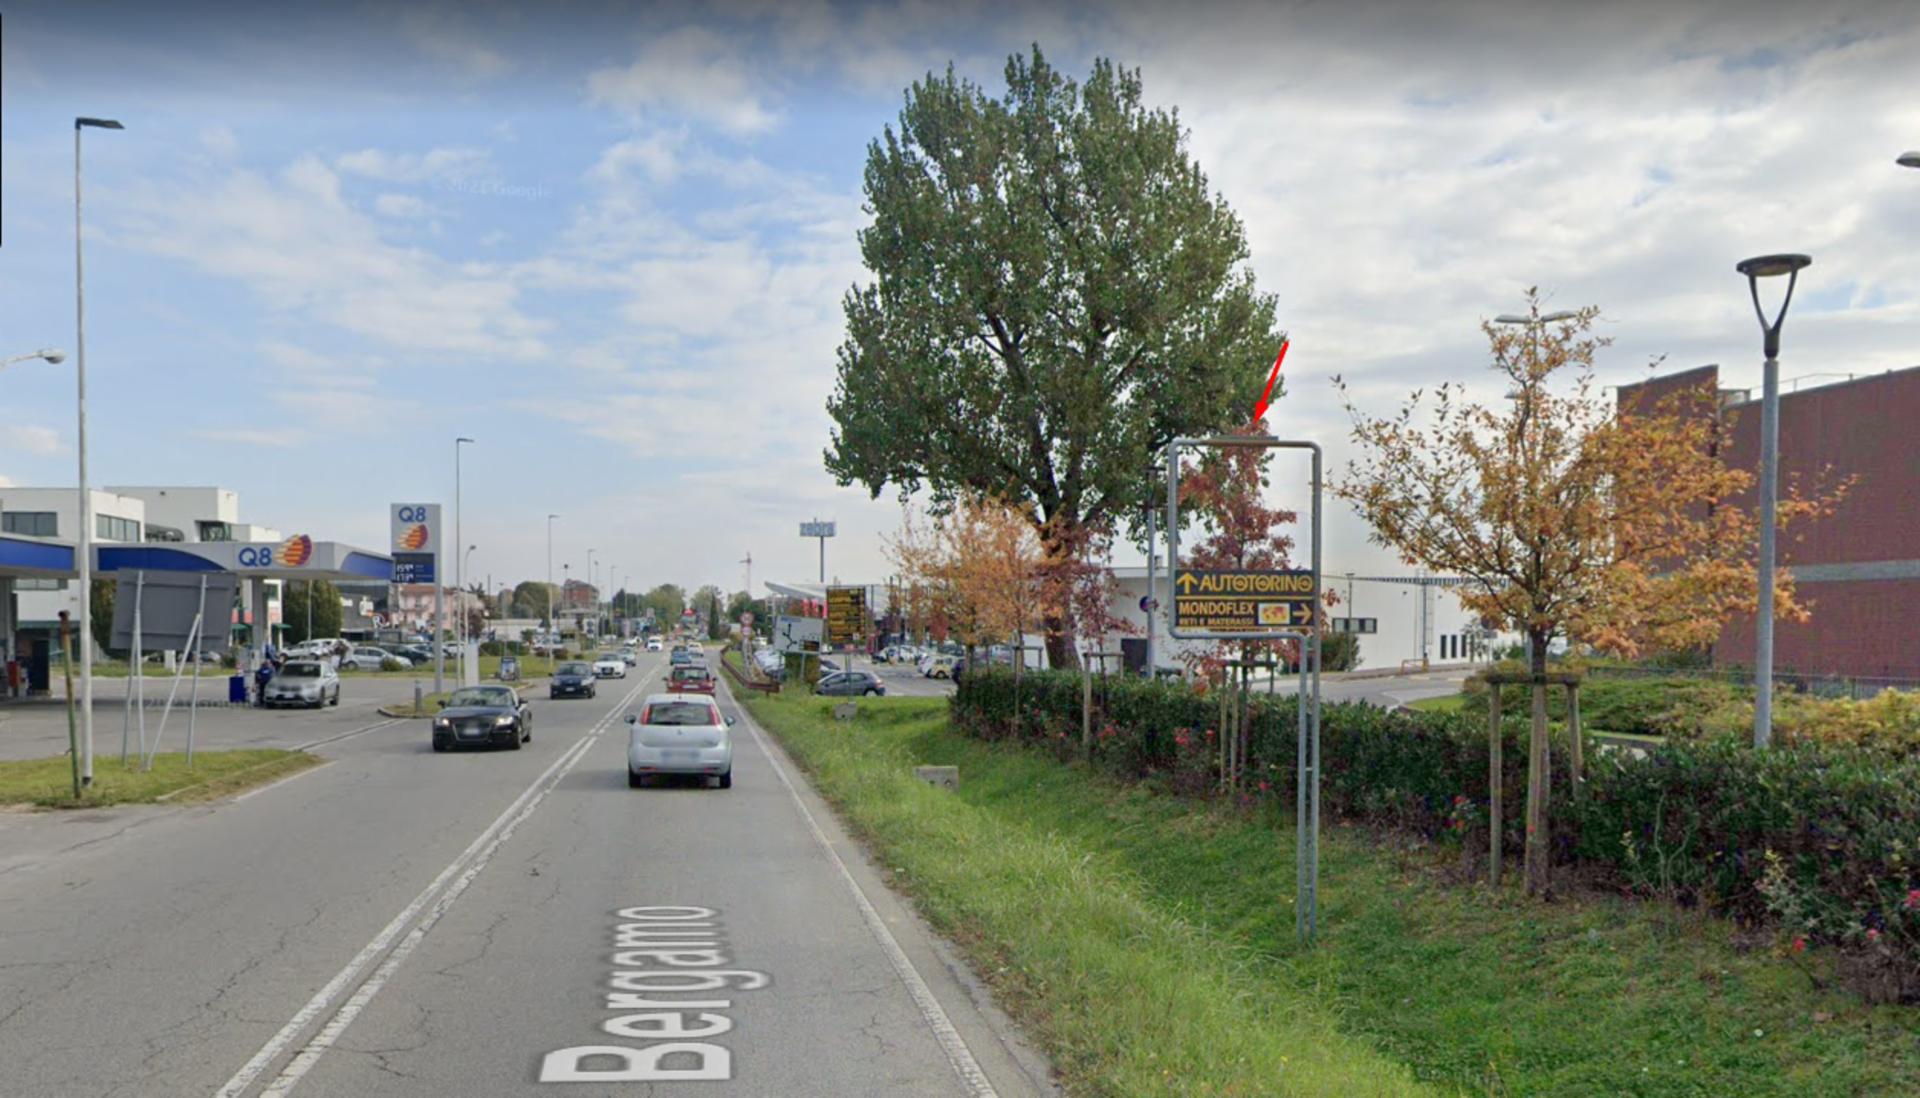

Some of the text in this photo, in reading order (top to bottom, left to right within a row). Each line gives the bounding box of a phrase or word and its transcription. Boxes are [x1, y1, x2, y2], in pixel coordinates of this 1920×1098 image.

[399, 507, 426, 523] Q8
[239, 547, 272, 567] Q8
[1200, 575, 1313, 592] AUTOTORINO
[1179, 602, 1255, 615] MONDOFLEX
